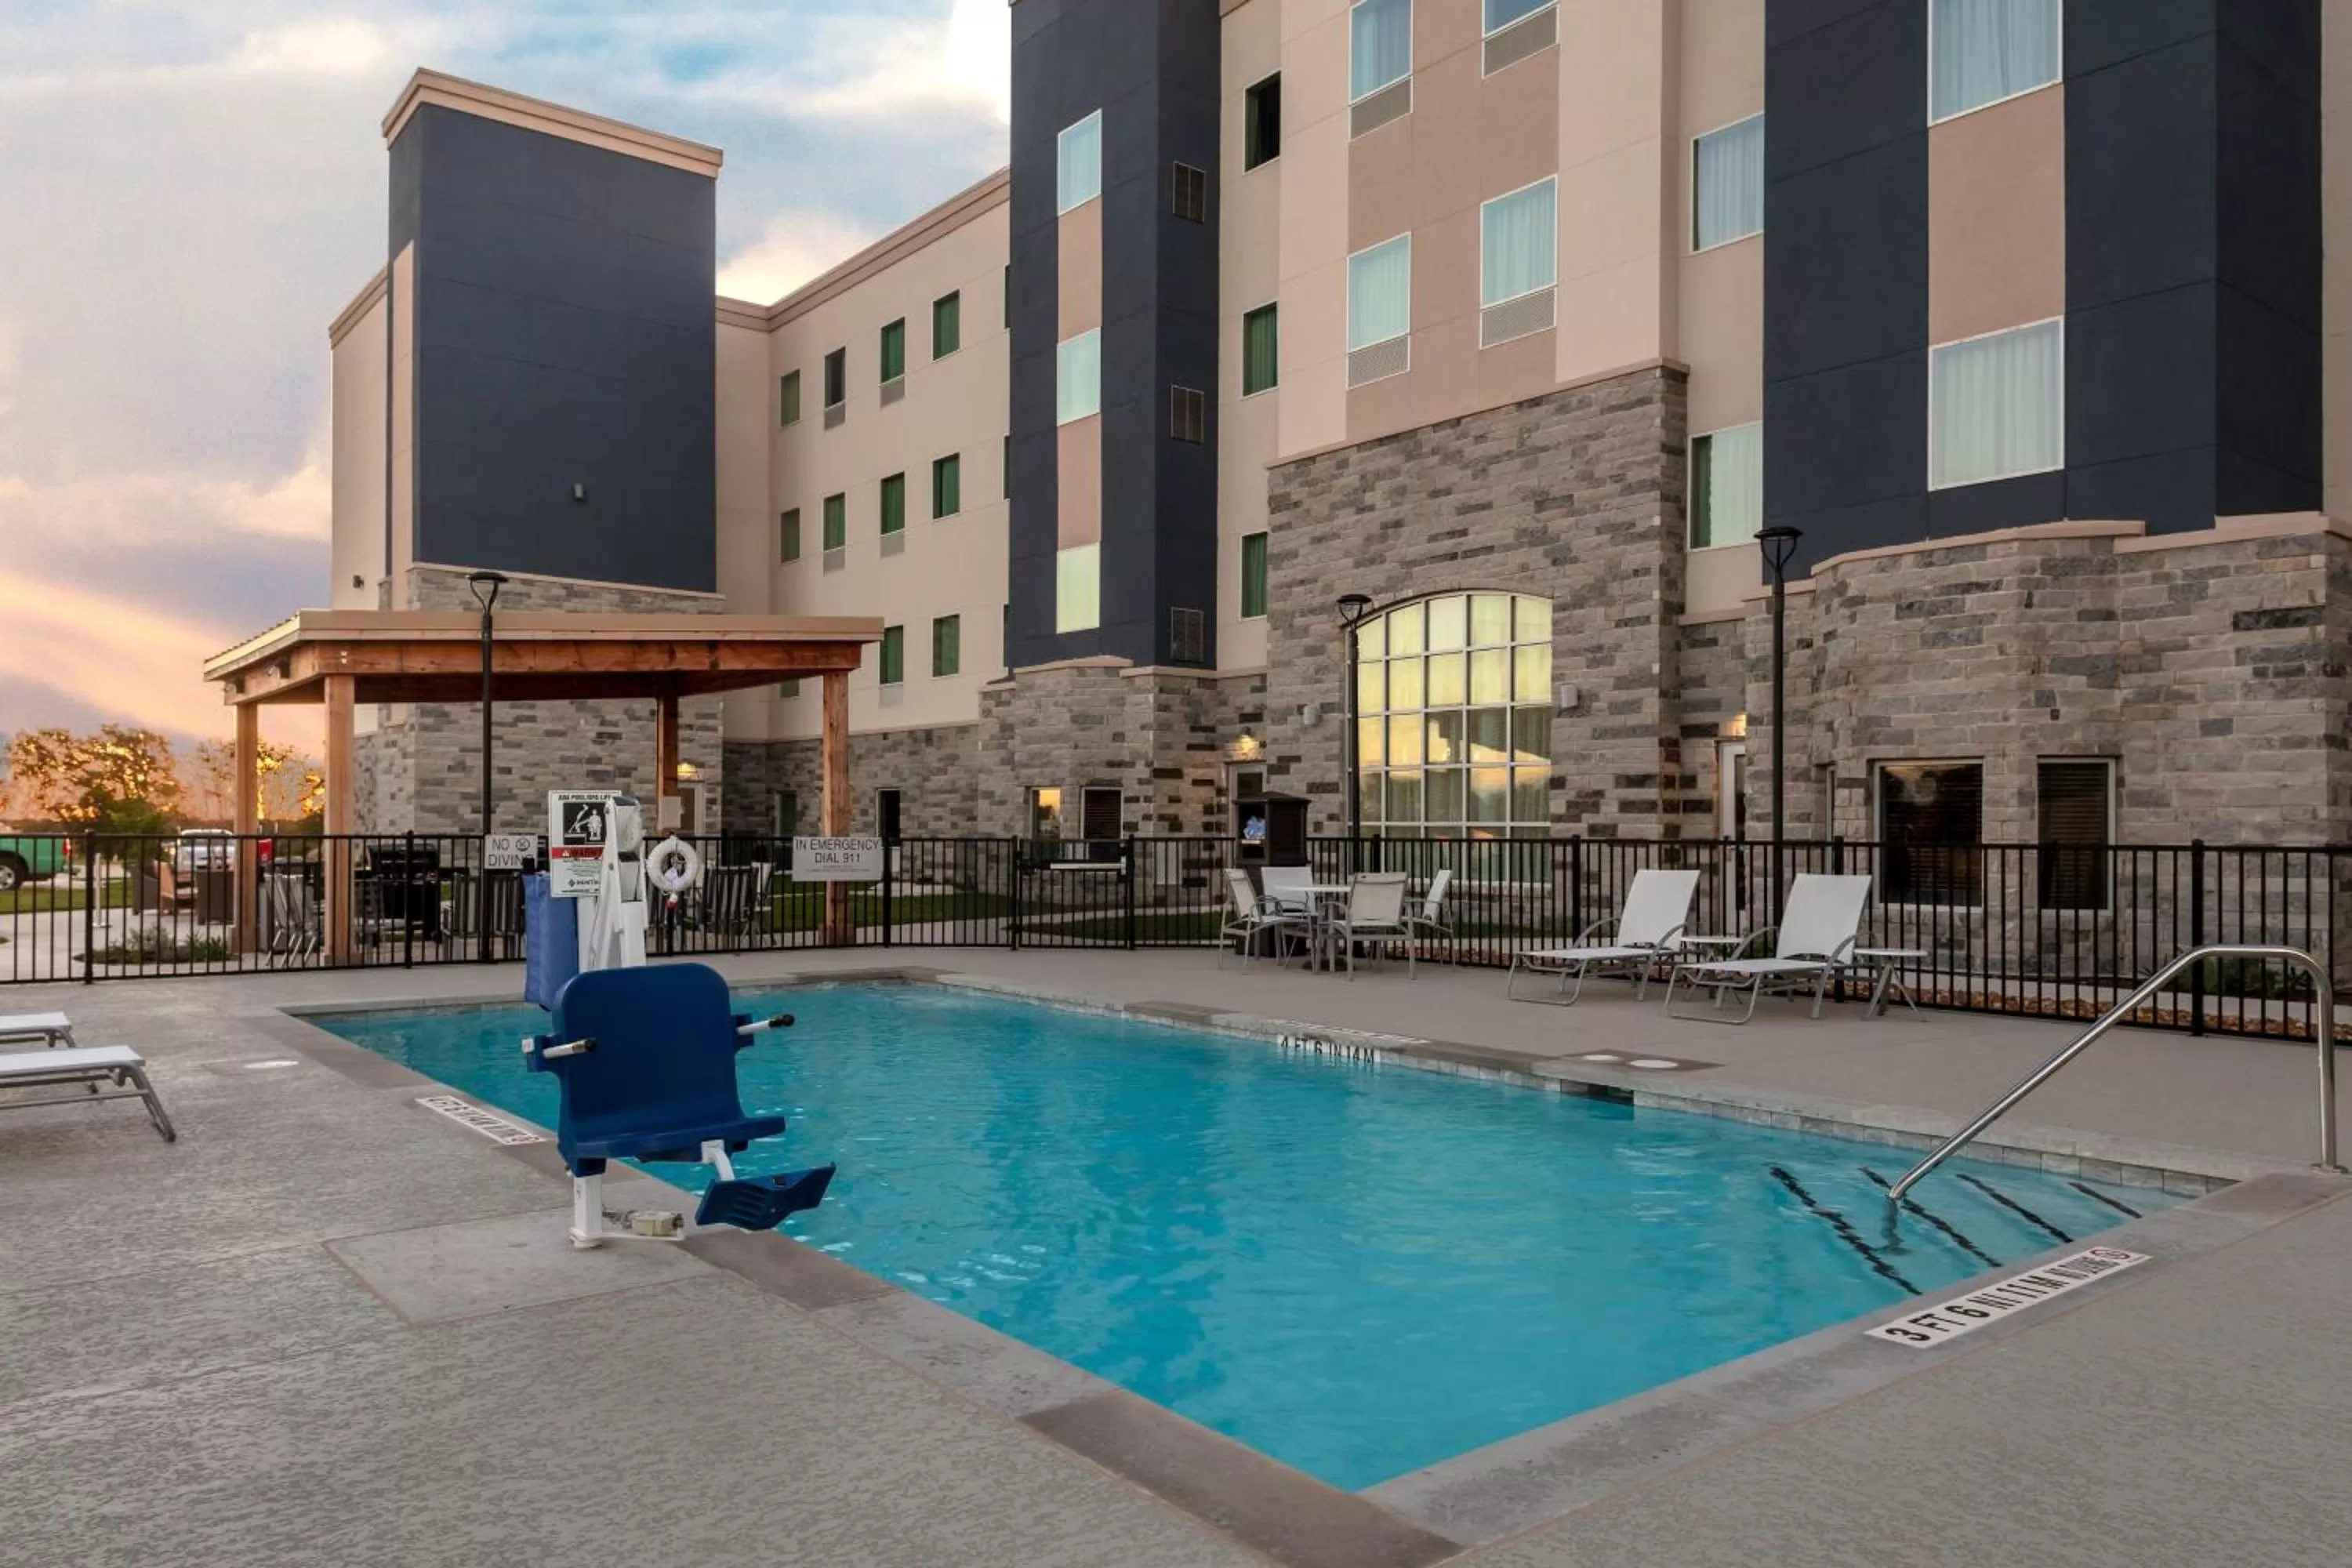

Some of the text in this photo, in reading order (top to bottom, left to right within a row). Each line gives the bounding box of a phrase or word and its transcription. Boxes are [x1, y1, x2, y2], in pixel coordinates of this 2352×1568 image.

[492, 838, 510, 851] NO
[795, 839, 879, 850] IN EMERGENCY
[489, 854, 533, 866] DIVIN
[815, 852, 860, 863] DIAL 911
[1944, 1305, 1991, 1318] 6
[1907, 1312, 1967, 1332] FT
[1885, 1327, 1931, 1341] 3
